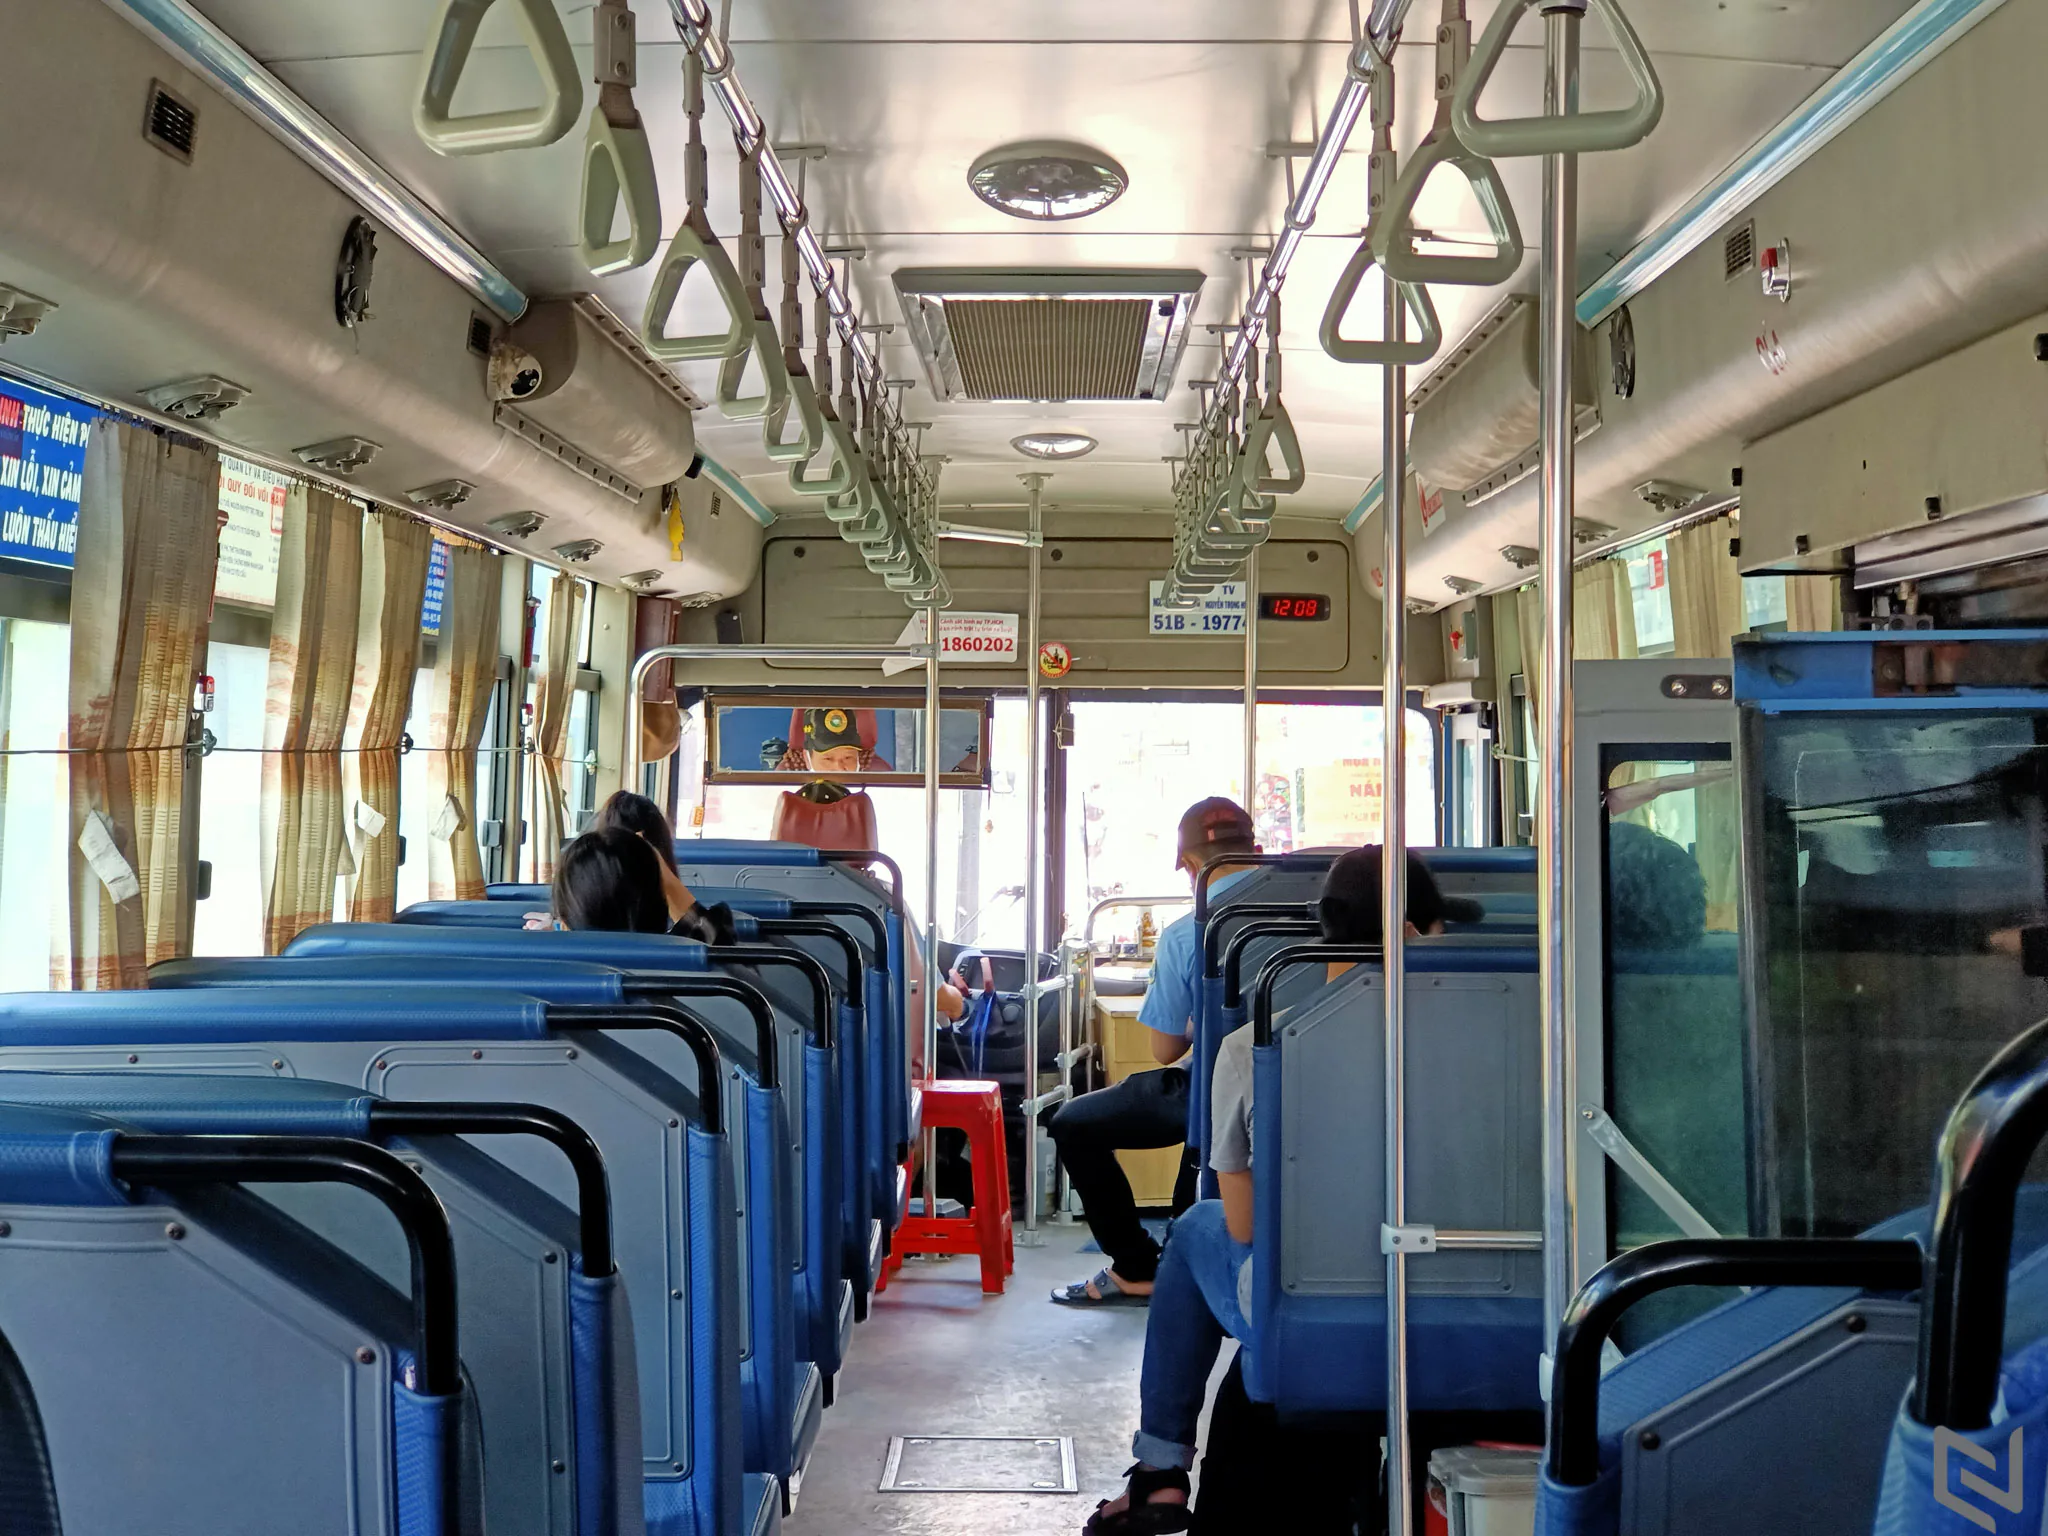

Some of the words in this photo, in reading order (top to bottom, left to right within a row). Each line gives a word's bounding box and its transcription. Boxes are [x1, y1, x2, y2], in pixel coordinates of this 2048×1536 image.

[23, 404, 51, 441] THỰC
[51, 411, 79, 448] HIỆN
[0, 454, 20, 489] XIN
[41, 465, 60, 498] XIN
[61, 460, 82, 503] CẢM
[2, 506, 31, 545] LUÔN
[32, 508, 59, 550] THẤU
[57, 511, 78, 553] HIỂ
[1222, 585, 1235, 595] TV
[1153, 614, 1185, 630] 51B
